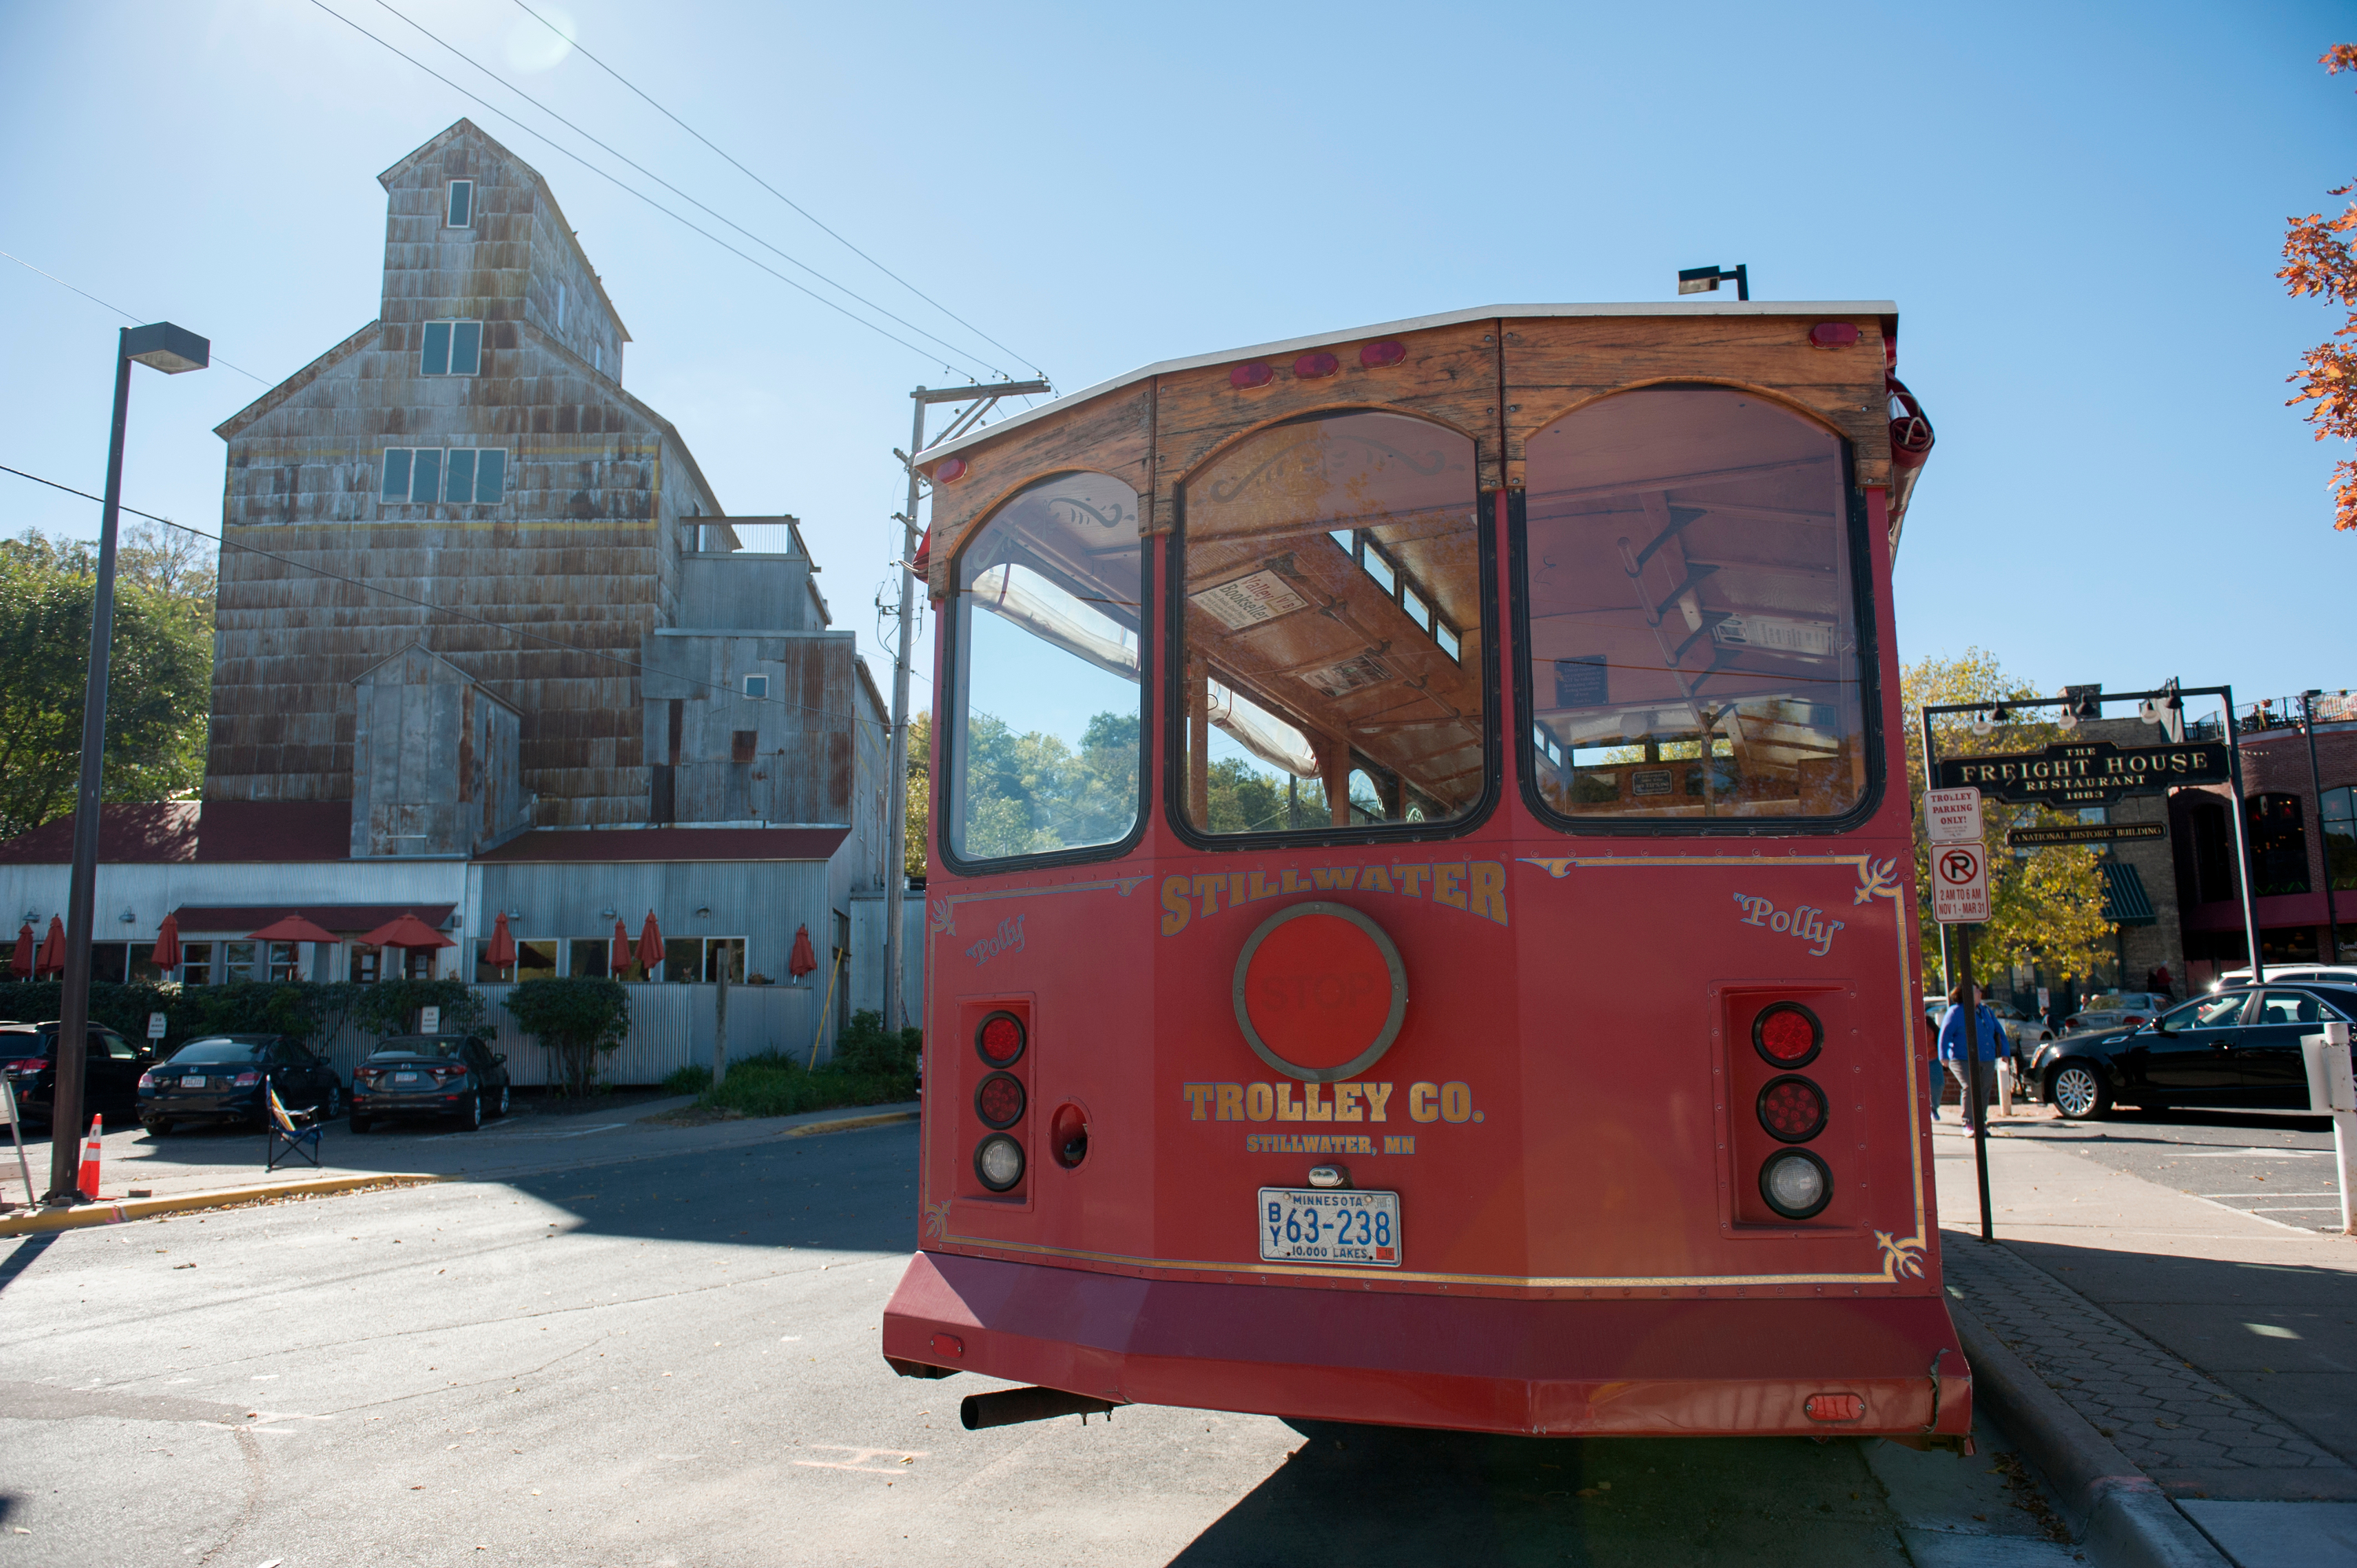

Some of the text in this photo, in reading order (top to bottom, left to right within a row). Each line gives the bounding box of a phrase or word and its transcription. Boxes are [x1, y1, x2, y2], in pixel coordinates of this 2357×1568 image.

[1241, 576, 1274, 601] Valley
[1219, 583, 1270, 621] Bookseller
[2066, 748, 2095, 757] THE
[1960, 752, 2208, 786] FREIGHT HOUSE
[2025, 775, 2146, 791] RESTAURANT
[1930, 793, 1971, 802] TROLLEY
[2066, 790, 2104, 800] 1883
[1933, 804, 1972, 814] PARKING
[1940, 816, 1967, 825] ONLY!
[2022, 832, 2066, 841] NATIONAL
[2069, 830, 2113, 840] HISTORIC
[2116, 827, 2161, 837] BUILDING
[1160, 860, 1508, 936] STILLWATER
[1940, 888, 1981, 900] 2 AM TO 6 AM
[1939, 903, 1951, 914] NOV
[1962, 903, 1977, 914] MAR
[1978, 902, 1985, 913] 31
[1261, 972, 1375, 1012] STOP
[1183, 1081, 1485, 1123] TROLLEY CO.
[1246, 1134, 1415, 1156] STILLWATER, MN
[1293, 1196, 1363, 1207] MINNESOTA
[1286, 1208, 1391, 1247] 63-238
[1332, 1247, 1368, 1258] LAKES
